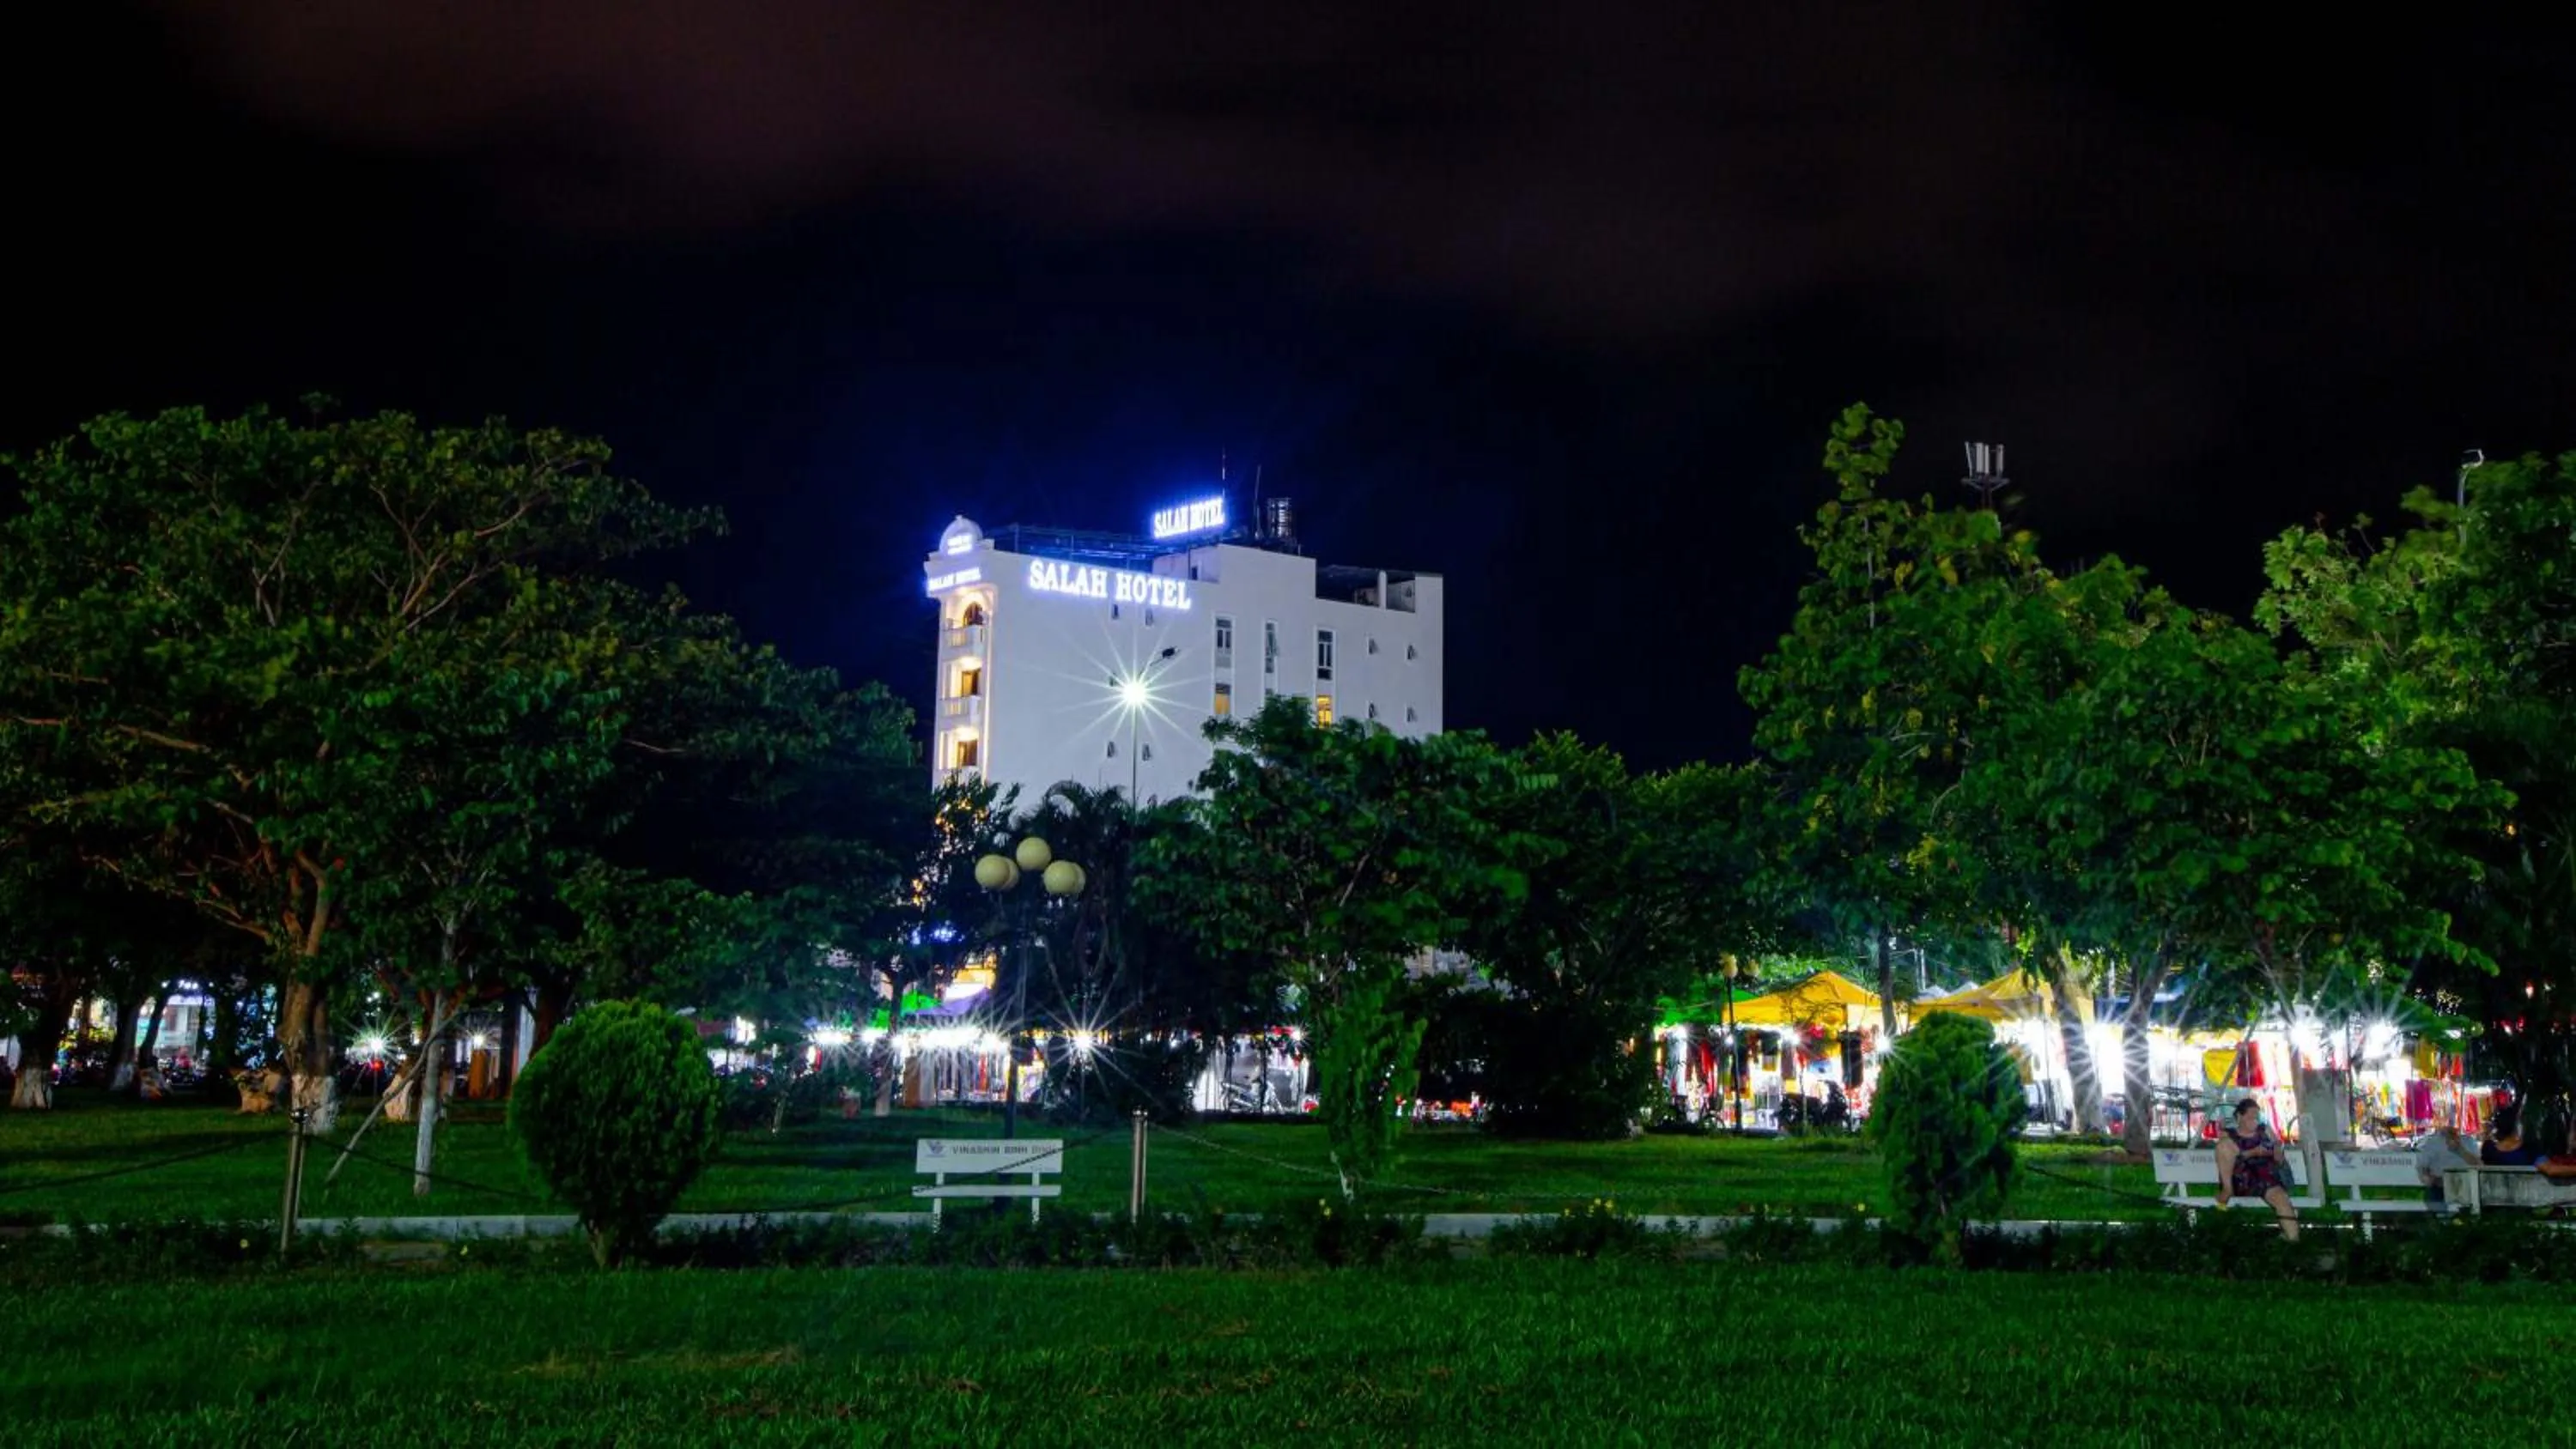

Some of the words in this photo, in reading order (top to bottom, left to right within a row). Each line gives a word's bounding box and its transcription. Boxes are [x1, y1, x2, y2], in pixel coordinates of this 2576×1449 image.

[1153, 505, 1188, 538] SALAH
[1029, 558, 1108, 598] SALAH
[1115, 572, 1192, 609] HOTEL
